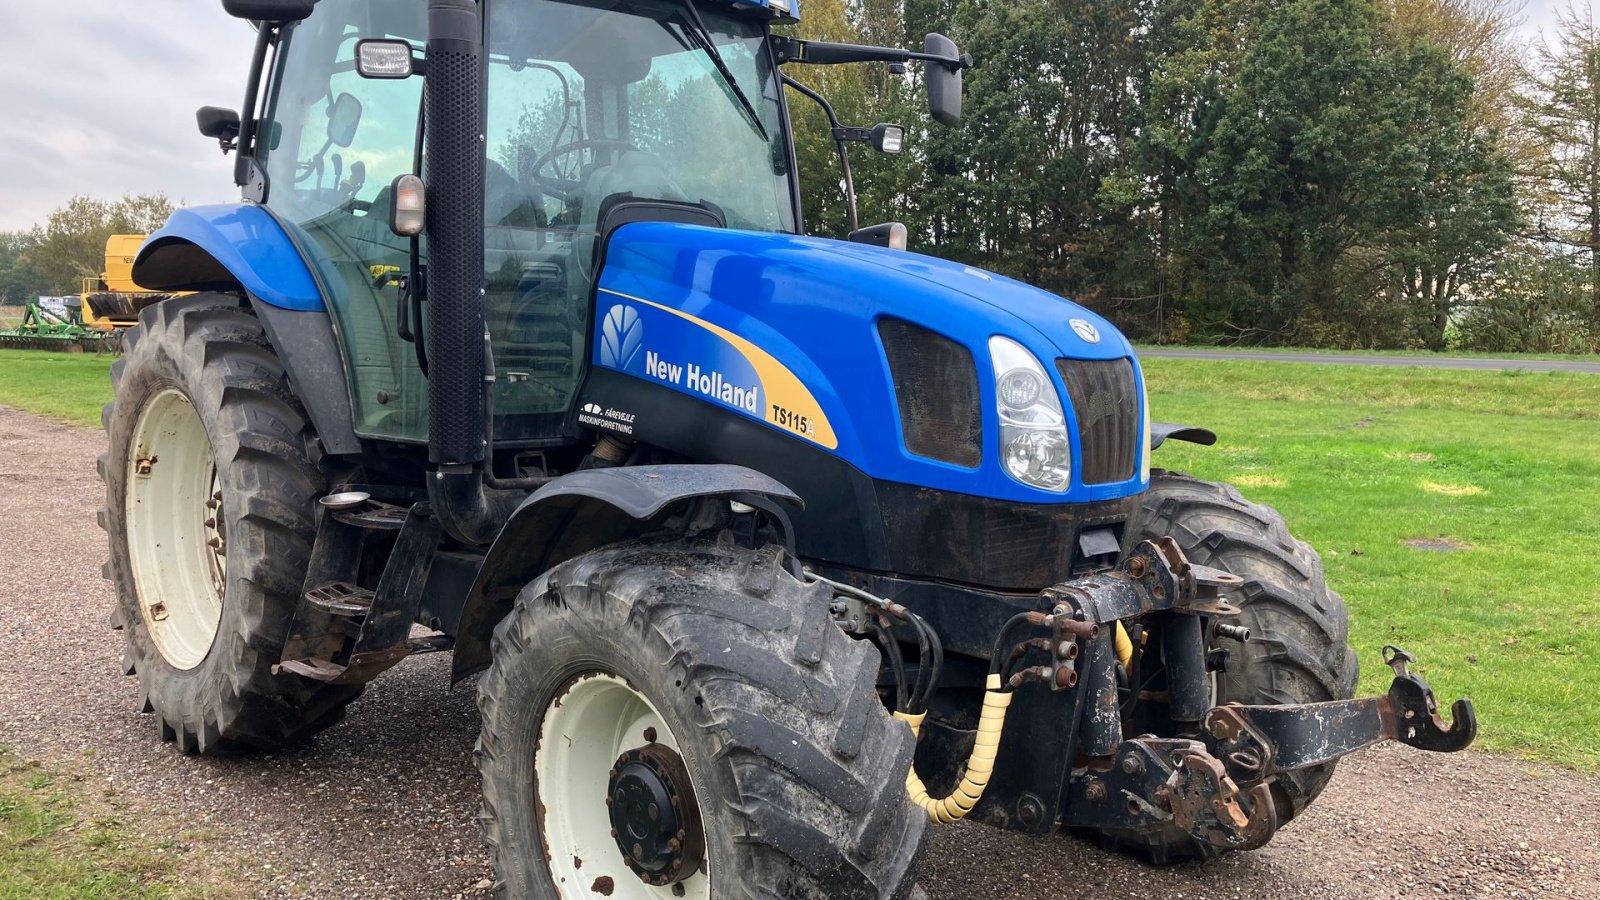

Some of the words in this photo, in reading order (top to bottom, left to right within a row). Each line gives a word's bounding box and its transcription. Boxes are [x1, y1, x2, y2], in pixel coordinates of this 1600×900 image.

[645, 350, 683, 385] New
[686, 362, 758, 413] Holland
[578, 413, 633, 435] MASKINFORRETNING
[604, 407, 636, 423] FÅREVEJLE
[772, 404, 816, 439] TS115A
